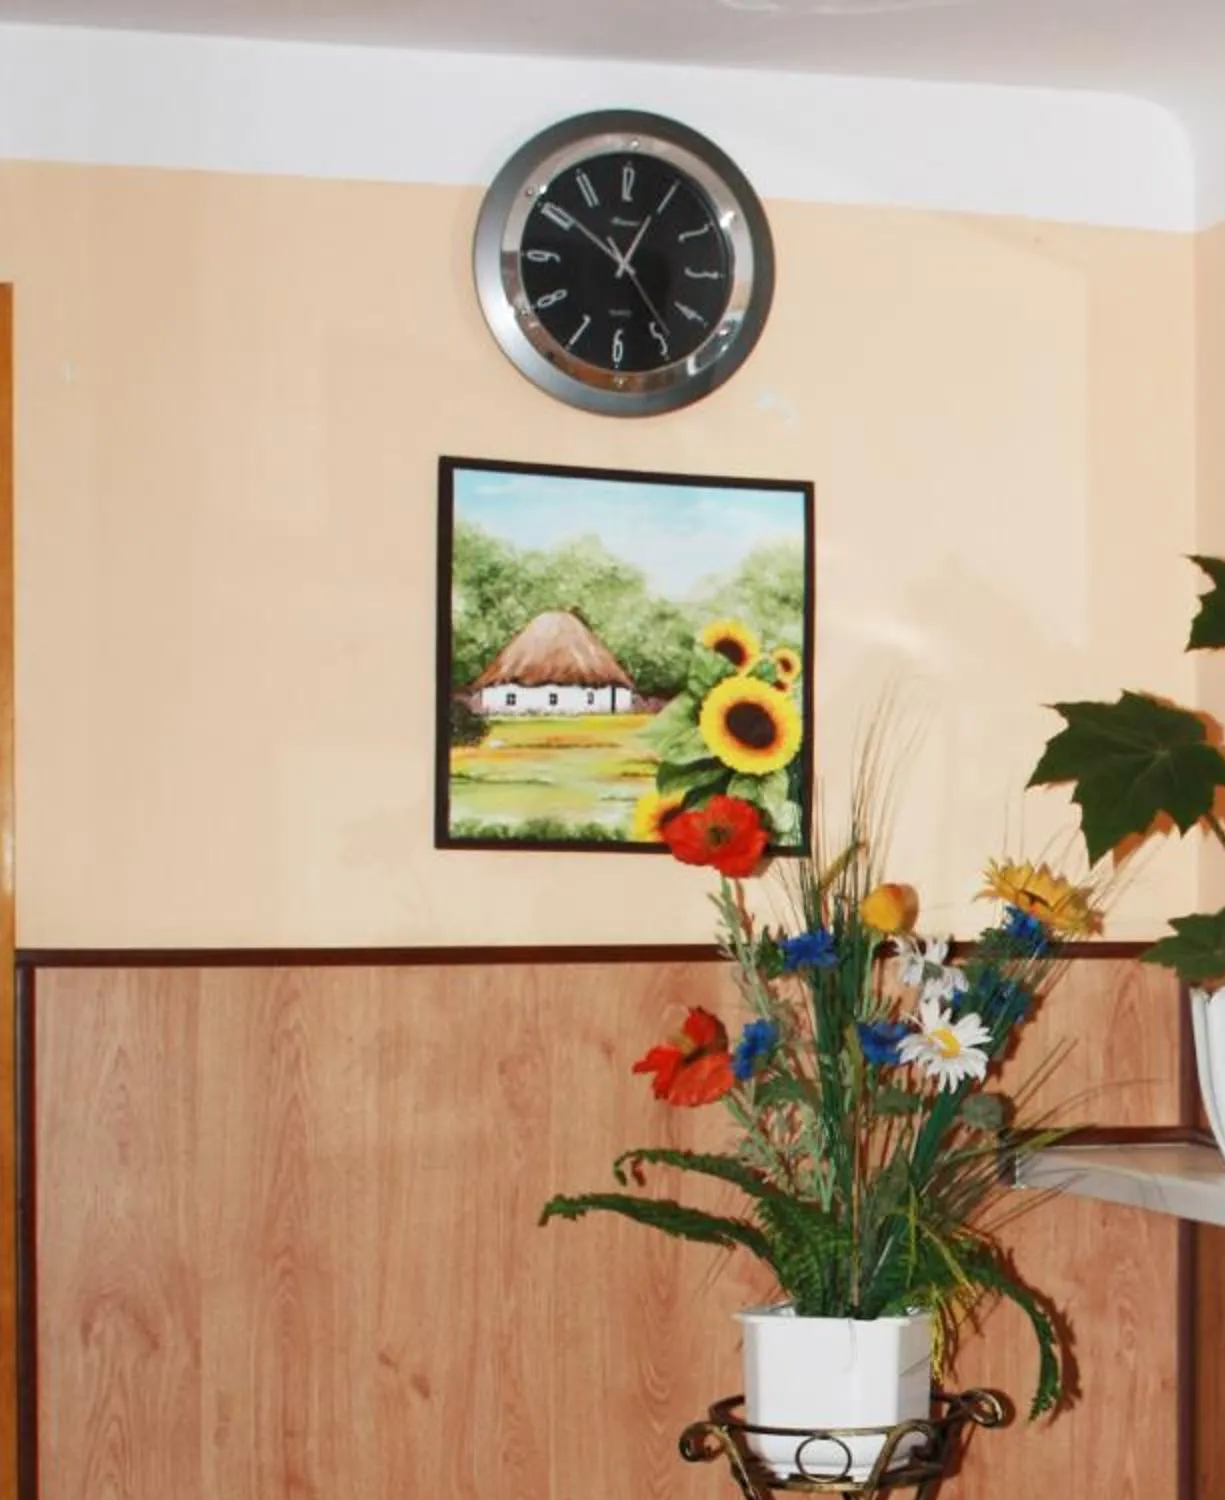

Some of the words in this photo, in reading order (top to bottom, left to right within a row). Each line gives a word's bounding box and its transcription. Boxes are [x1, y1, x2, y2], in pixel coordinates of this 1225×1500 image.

[576, 172, 600, 208] 11
[657, 181, 681, 214] 1
[541, 202, 575, 231] 10
[678, 223, 710, 242] 2
[525, 249, 561, 264] 9
[535, 288, 568, 310] 8
[567, 313, 592, 348] 7
[611, 328, 624, 364] 6
[649, 322, 668, 356] 5
